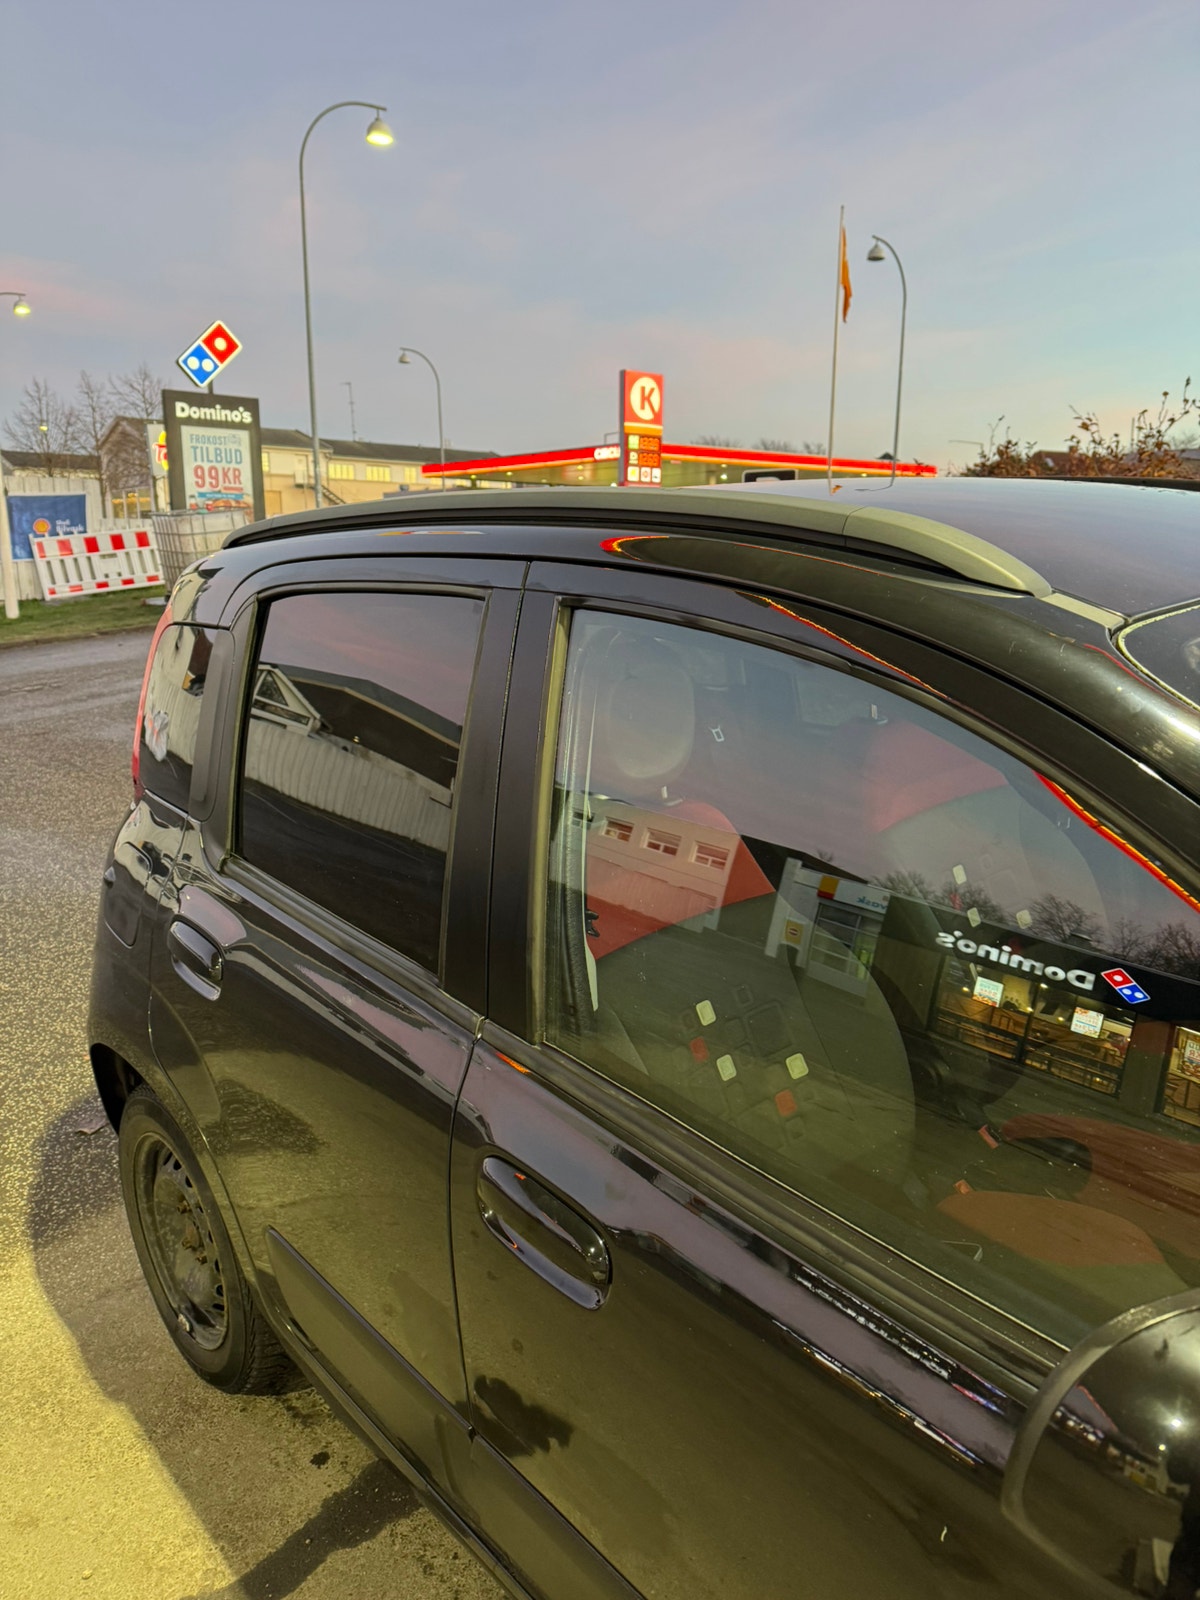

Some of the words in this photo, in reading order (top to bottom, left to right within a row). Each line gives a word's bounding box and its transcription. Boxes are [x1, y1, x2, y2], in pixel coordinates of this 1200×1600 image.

[175, 401, 253, 424] Domino's
[190, 433, 227, 445] FROKOST
[191, 446, 243, 465] TILBUD
[193, 464, 220, 489] 99
[222, 466, 242, 485] KR
